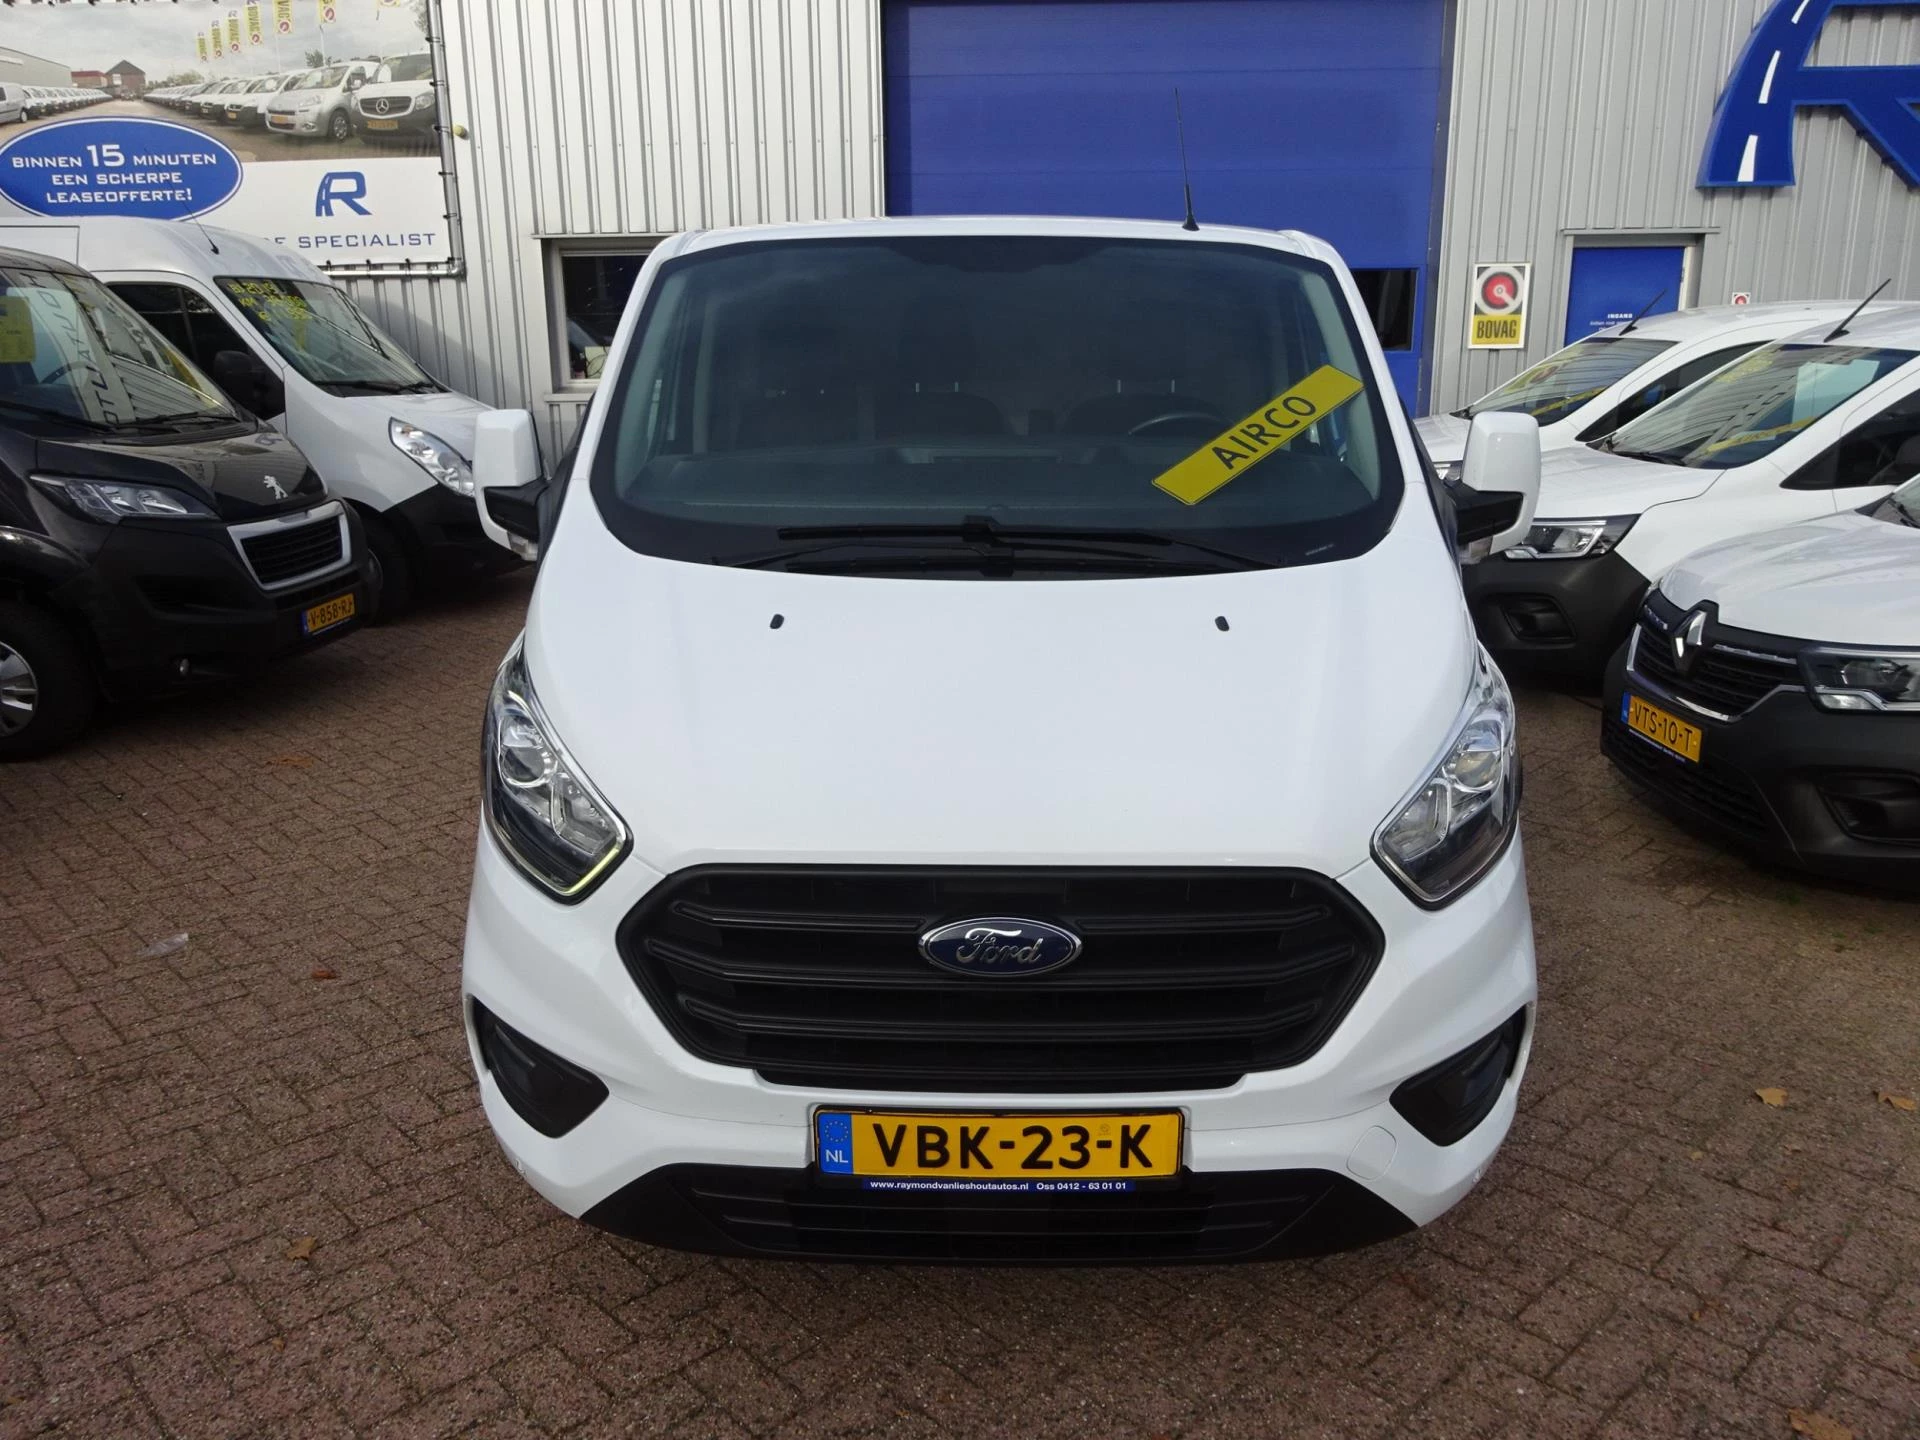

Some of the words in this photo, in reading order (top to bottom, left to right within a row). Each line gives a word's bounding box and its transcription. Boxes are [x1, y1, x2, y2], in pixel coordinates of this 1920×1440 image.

[12, 156, 82, 168] BINNEN
[87, 144, 125, 167] 15
[133, 153, 217, 166] MINUTEN
[52, 174, 88, 185] EEN
[96, 172, 183, 184] SCHERPE
[47, 188, 193, 204] LEASEOFFERTE!
[298, 233, 436, 248] SPECIALIST
[1476, 319, 1517, 339] BOVAG
[1212, 396, 1316, 470] AIRCO
[1634, 702, 1693, 752] VTS-10-T
[956, 928, 1044, 964] Ford
[825, 1149, 849, 1163] NL
[872, 1123, 1153, 1169] VBK-23-K
[870, 1181, 1029, 1191] www.raymondvanlieshoutautos.nl
[1036, 1182, 1055, 1190] Oss
[1057, 1182, 1080, 1190] 0412
[1088, 1182, 1098, 1190] 63
[1099, 1182, 1113, 1190] 01
[1115, 1182, 1126, 1190] 01
